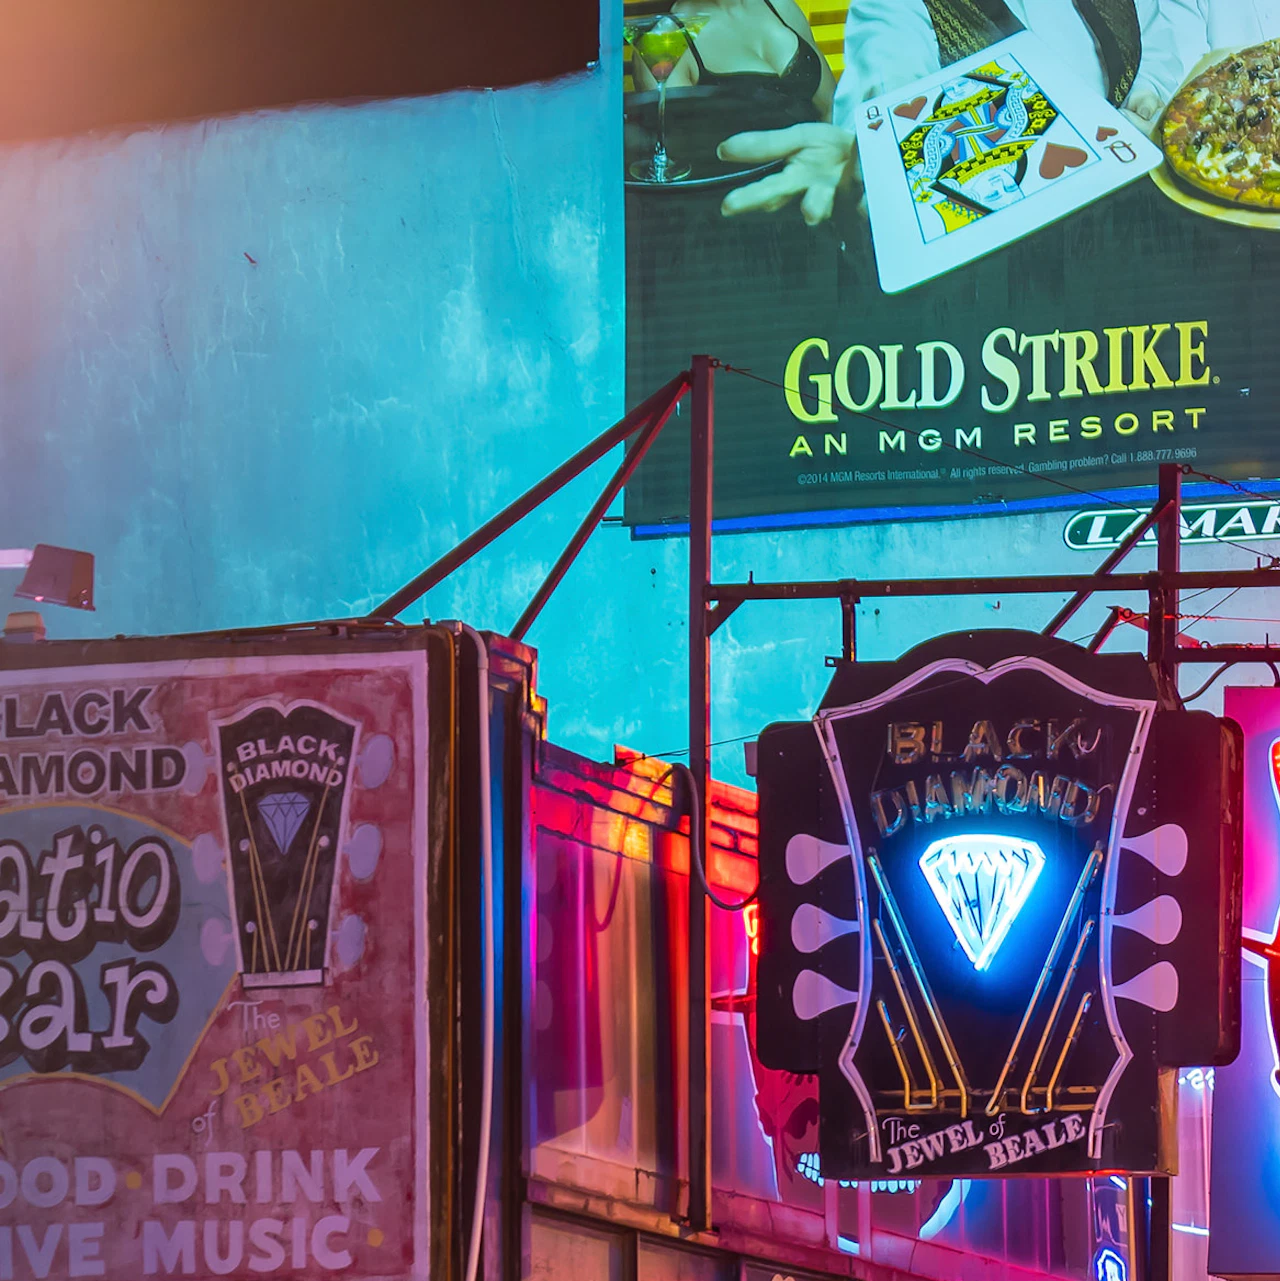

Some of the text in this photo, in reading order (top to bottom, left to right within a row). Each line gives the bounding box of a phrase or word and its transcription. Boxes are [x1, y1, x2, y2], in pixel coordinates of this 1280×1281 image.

[784, 320, 1212, 423] GOLD STRIKE
[789, 407, 1207, 458] AN MGM RESORT
[830, 470, 852, 483] MGM
[854, 469, 886, 482] Resorts
[950, 467, 962, 479] All
[963, 465, 986, 480] rights
[1028, 458, 1068, 475] Gambling
[1069, 454, 1109, 471] problem?
[1111, 452, 1127, 464] Call
[1129, 447, 1198, 463] 1.888.777.9696
[0, 686, 155, 740] LACK
[235, 733, 342, 765] BLACK
[886, 719, 1102, 765] BLACK
[230, 758, 345, 794] DIAMOND
[870, 766, 1114, 839] DIAMOND
[225, 999, 281, 1034] The
[208, 1004, 359, 1096] JEWEL
[192, 1035, 381, 1147] of BEALE
[881, 1116, 921, 1144] The
[886, 1112, 1086, 1174] JEWEL of BEALE
[152, 1146, 383, 1205] DRINK
[142, 1215, 354, 1276] MUSIC
